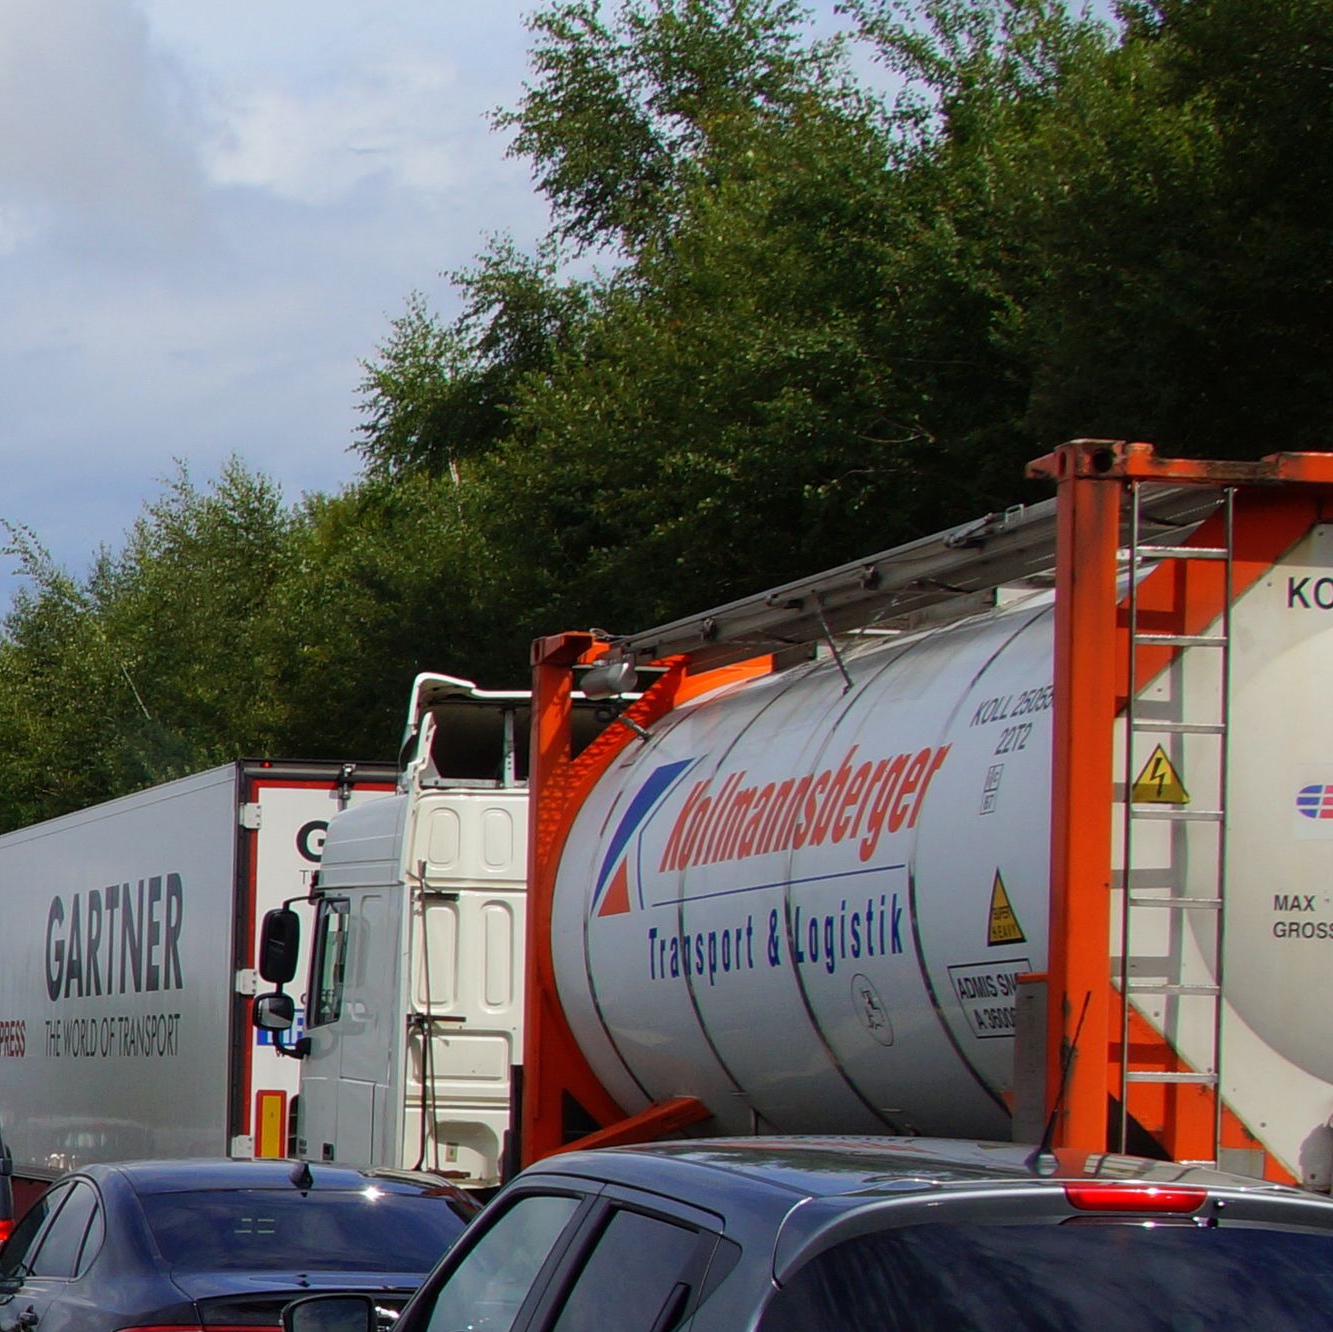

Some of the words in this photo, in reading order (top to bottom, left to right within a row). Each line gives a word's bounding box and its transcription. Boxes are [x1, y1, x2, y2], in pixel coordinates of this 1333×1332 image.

[969, 694, 1014, 728] KOLL
[994, 722, 1033, 755] 22T2
[659, 742, 953, 873] Kollmannsberger
[1273, 894, 1316, 911] MAX
[45, 872, 183, 1002] GARTNER
[648, 914, 754, 986] Transport
[767, 907, 781, 967] &
[793, 892, 903, 974] Logistik
[957, 975, 998, 1000] ADMIS
[45, 1020, 61, 1057] THE
[63, 1018, 97, 1057] WORLD
[100, 1017, 116, 1057] OF
[118, 1013, 181, 1057] TRANSPORT
